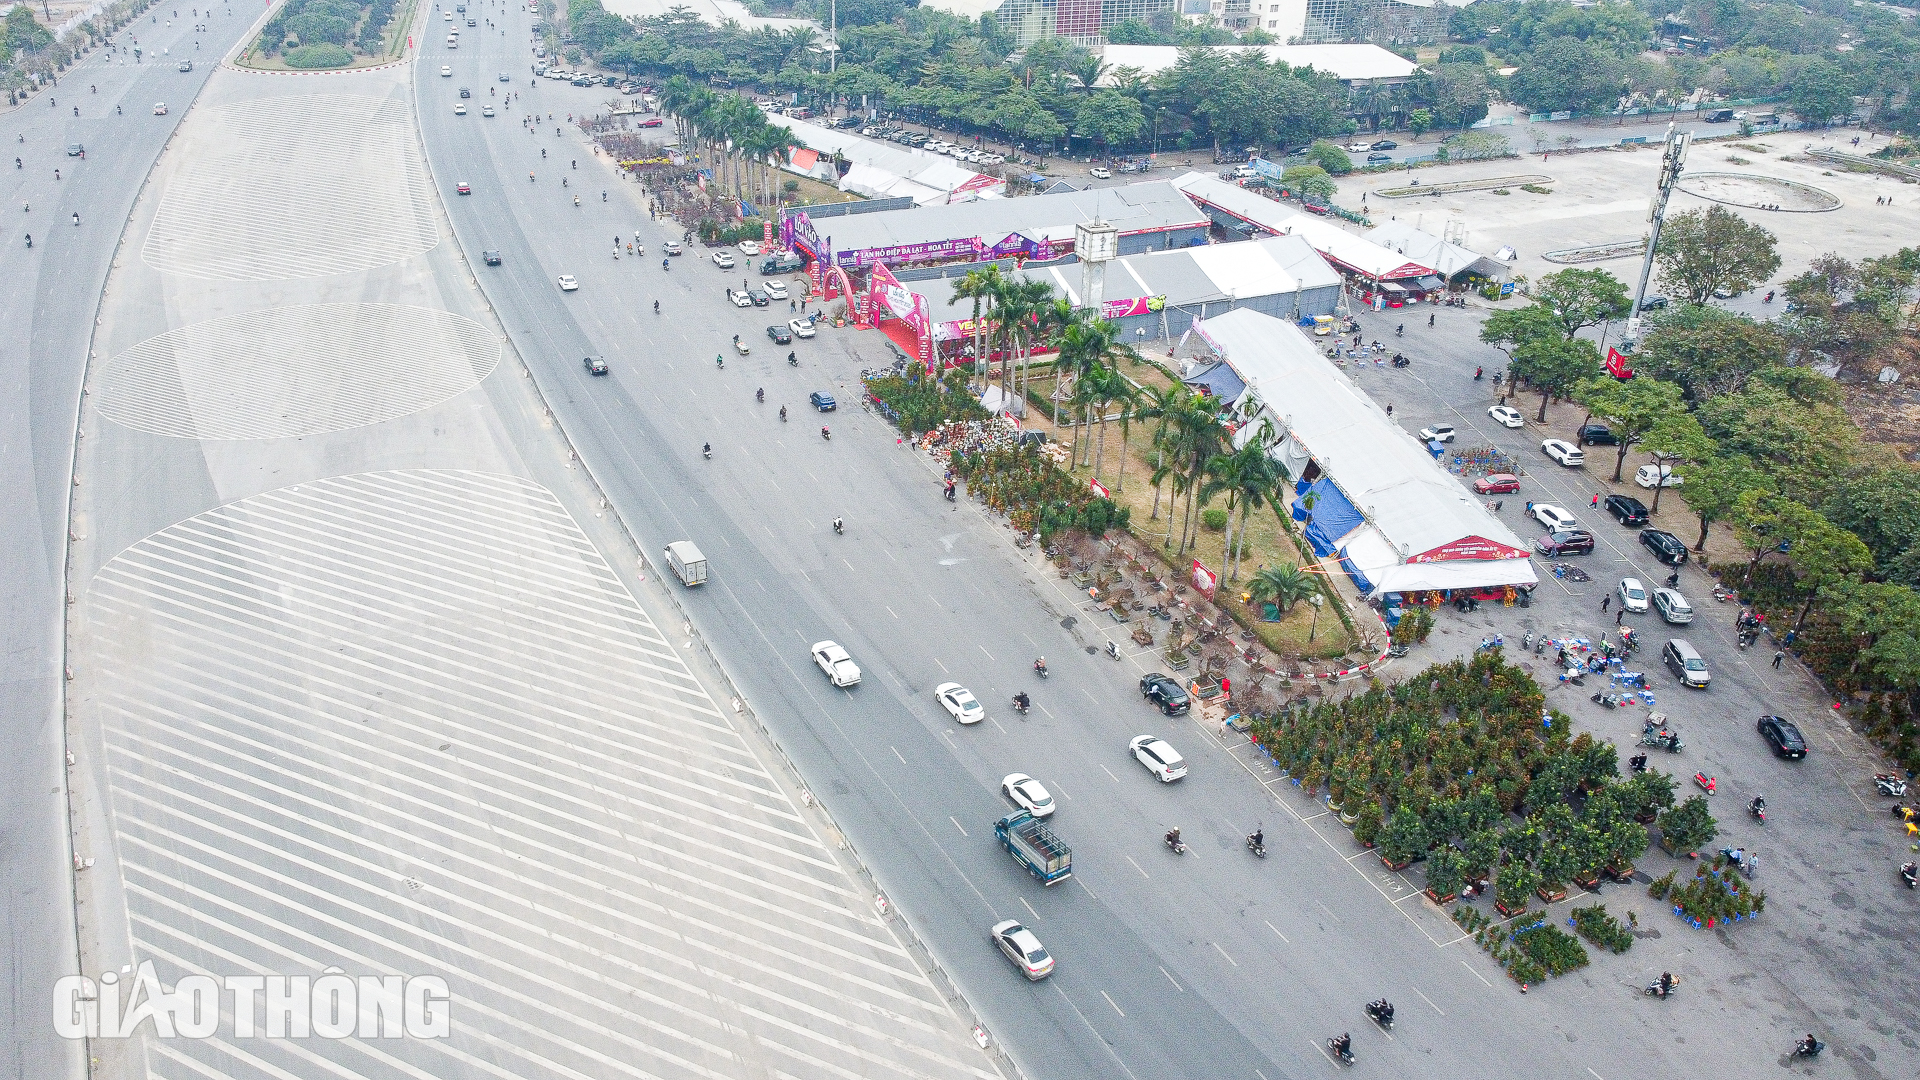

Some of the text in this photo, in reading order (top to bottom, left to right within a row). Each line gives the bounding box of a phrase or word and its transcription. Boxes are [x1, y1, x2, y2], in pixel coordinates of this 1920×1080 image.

[861, 250, 874, 258] LAN
[902, 246, 912, 255] ĐÀ
[928, 244, 942, 252] HOA
[943, 242, 954, 250] TẾT
